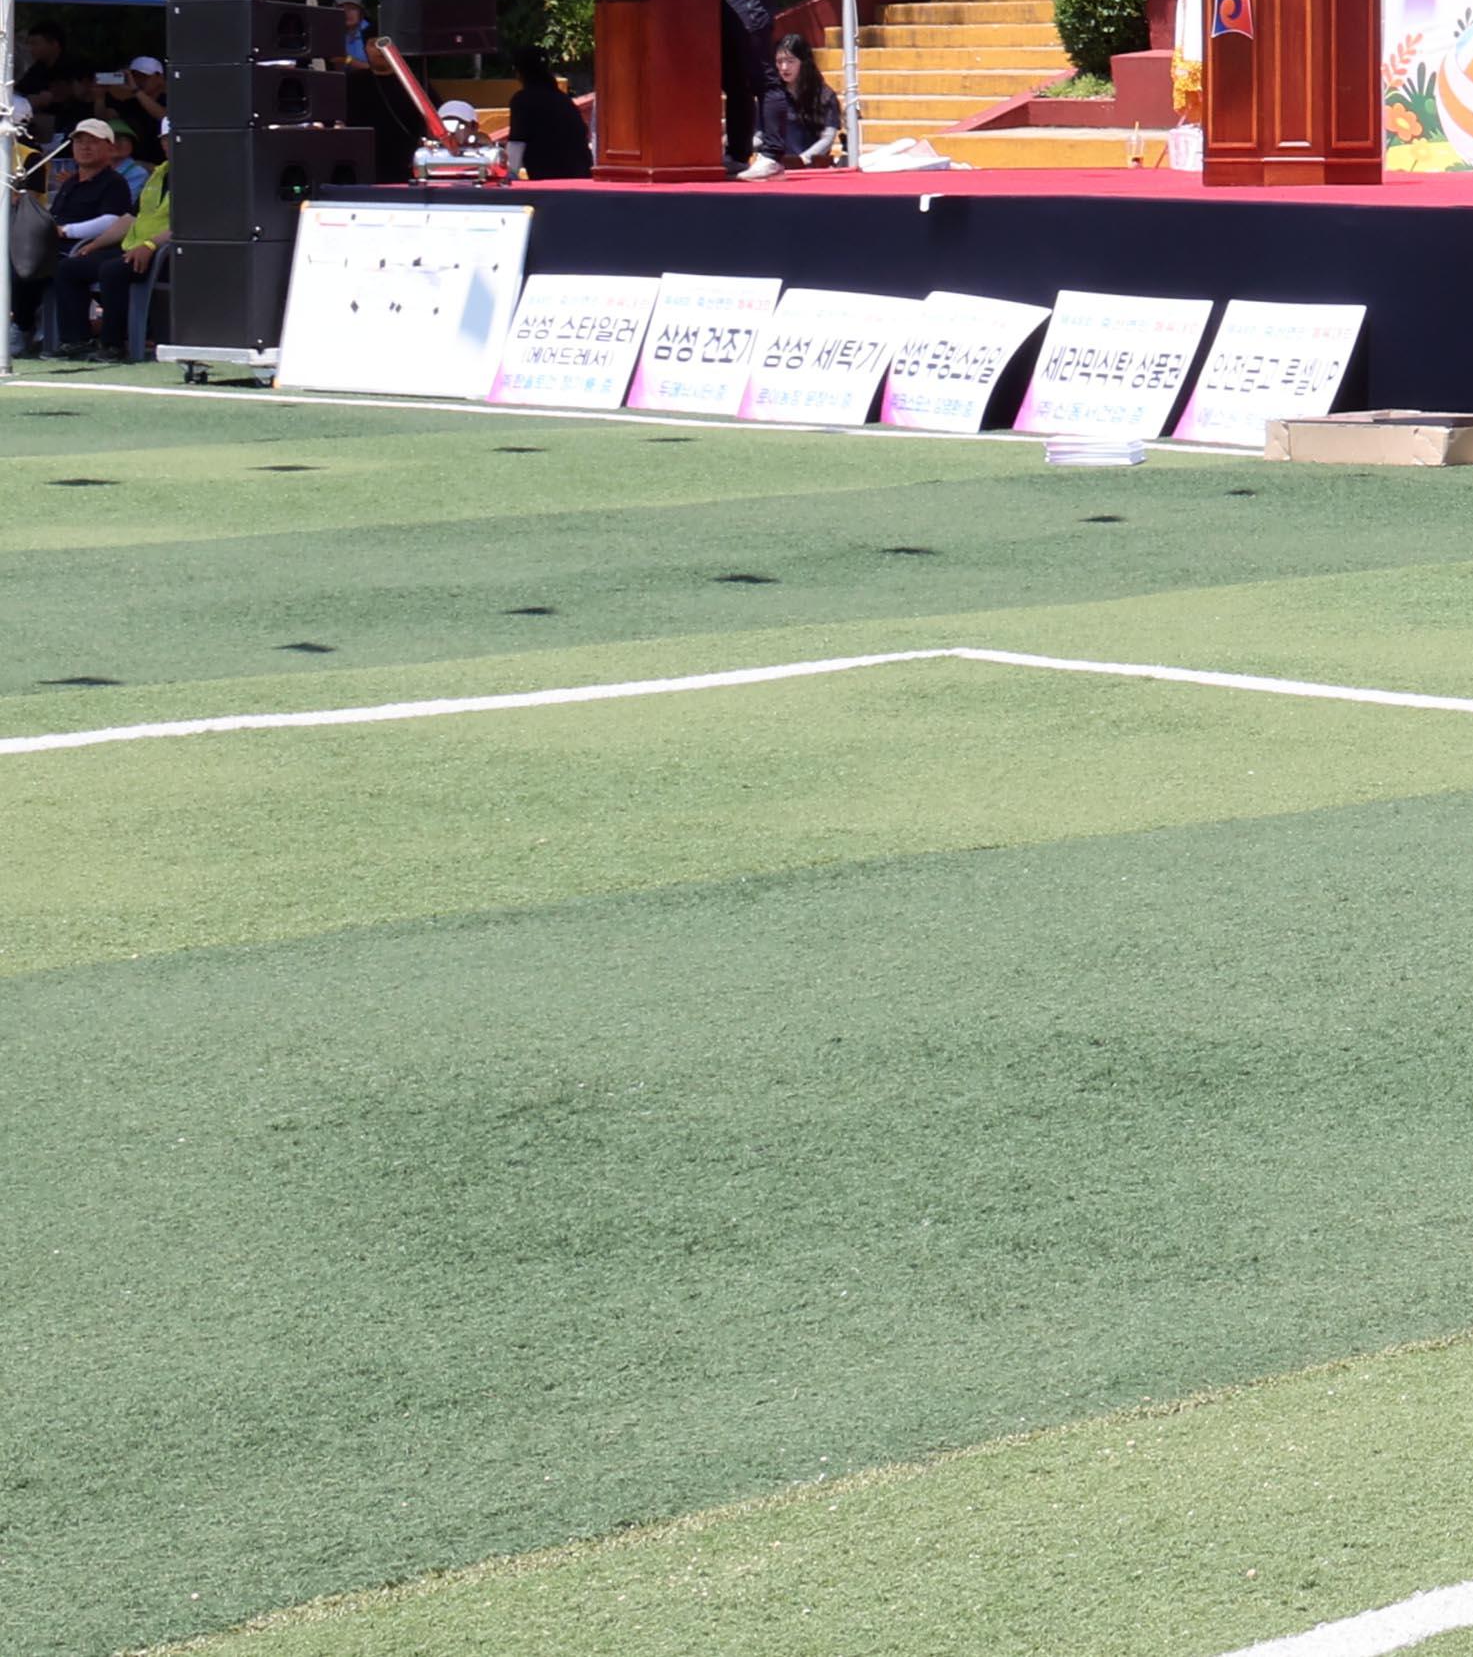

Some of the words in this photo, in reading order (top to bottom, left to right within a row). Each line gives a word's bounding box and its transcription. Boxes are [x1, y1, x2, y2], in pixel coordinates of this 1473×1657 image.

[517, 315, 555, 340] 삼성
[557, 316, 638, 343] 스타일러
[654, 323, 700, 362] 삼성
[701, 326, 760, 364] 건조기
[763, 335, 813, 369] 삼성
[812, 337, 887, 373] 세탁기
[893, 338, 929, 377] 삼성
[1041, 344, 1134, 385] 세라믹식탁
[1131, 350, 1188, 389] 상품권
